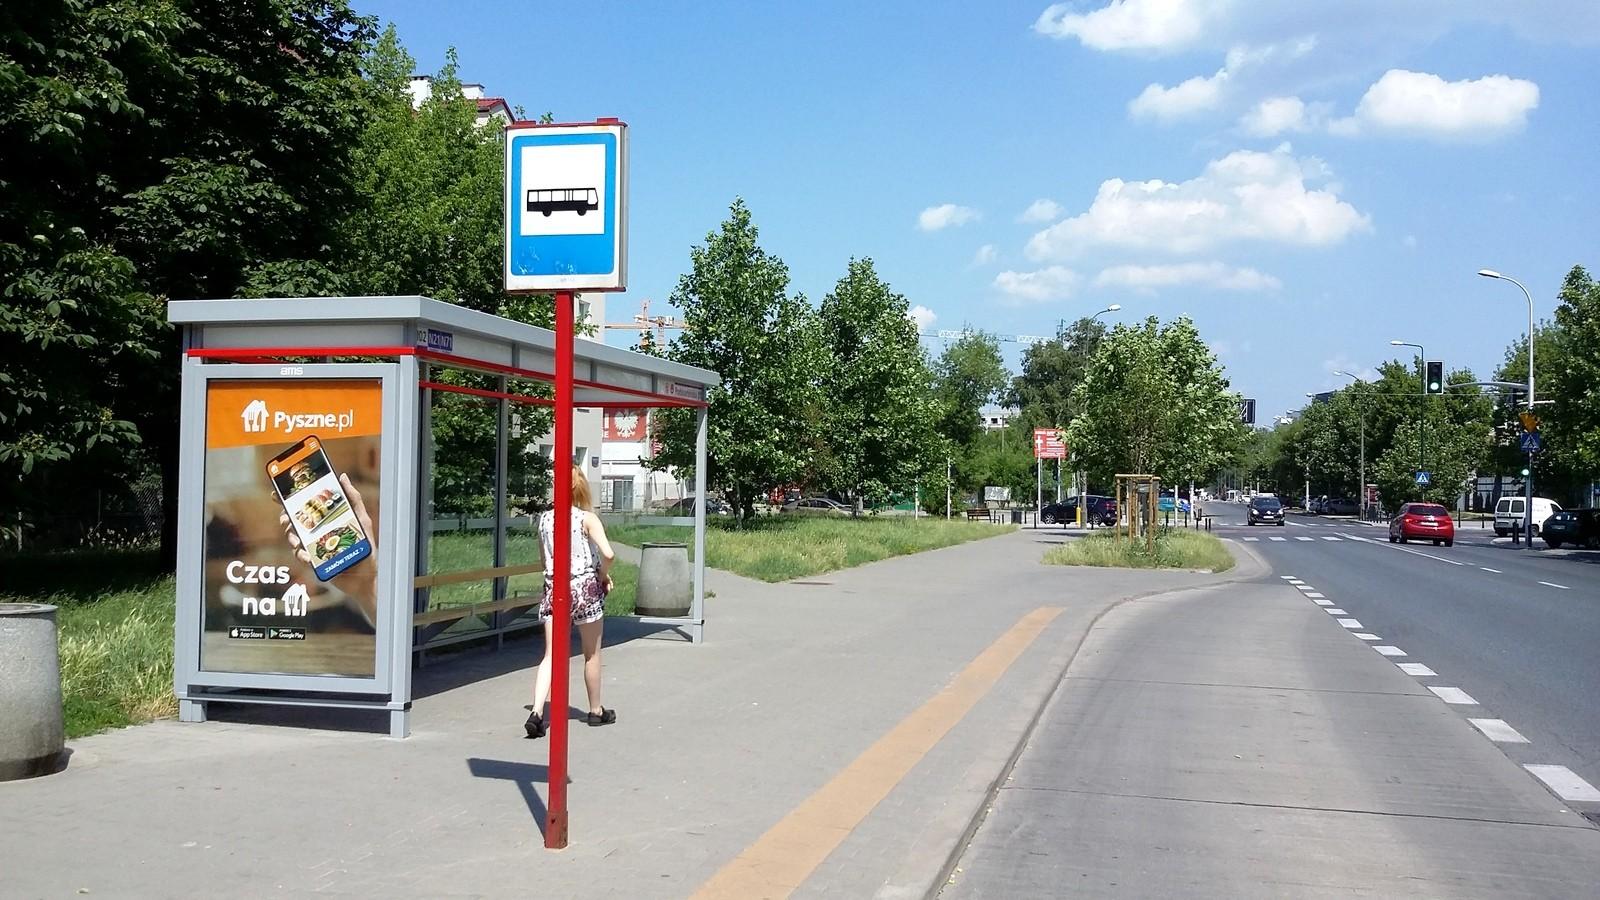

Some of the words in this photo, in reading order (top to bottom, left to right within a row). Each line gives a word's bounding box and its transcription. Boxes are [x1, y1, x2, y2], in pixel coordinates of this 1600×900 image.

[280, 366, 304, 376] ams
[274, 409, 354, 433] Pyszne.pl
[344, 549, 360, 561] TERAZ
[226, 560, 291, 584] Czas
[242, 596, 276, 616] na
[240, 631, 250, 639] App
[279, 631, 294, 639] Google
[294, 632, 304, 640] Play
